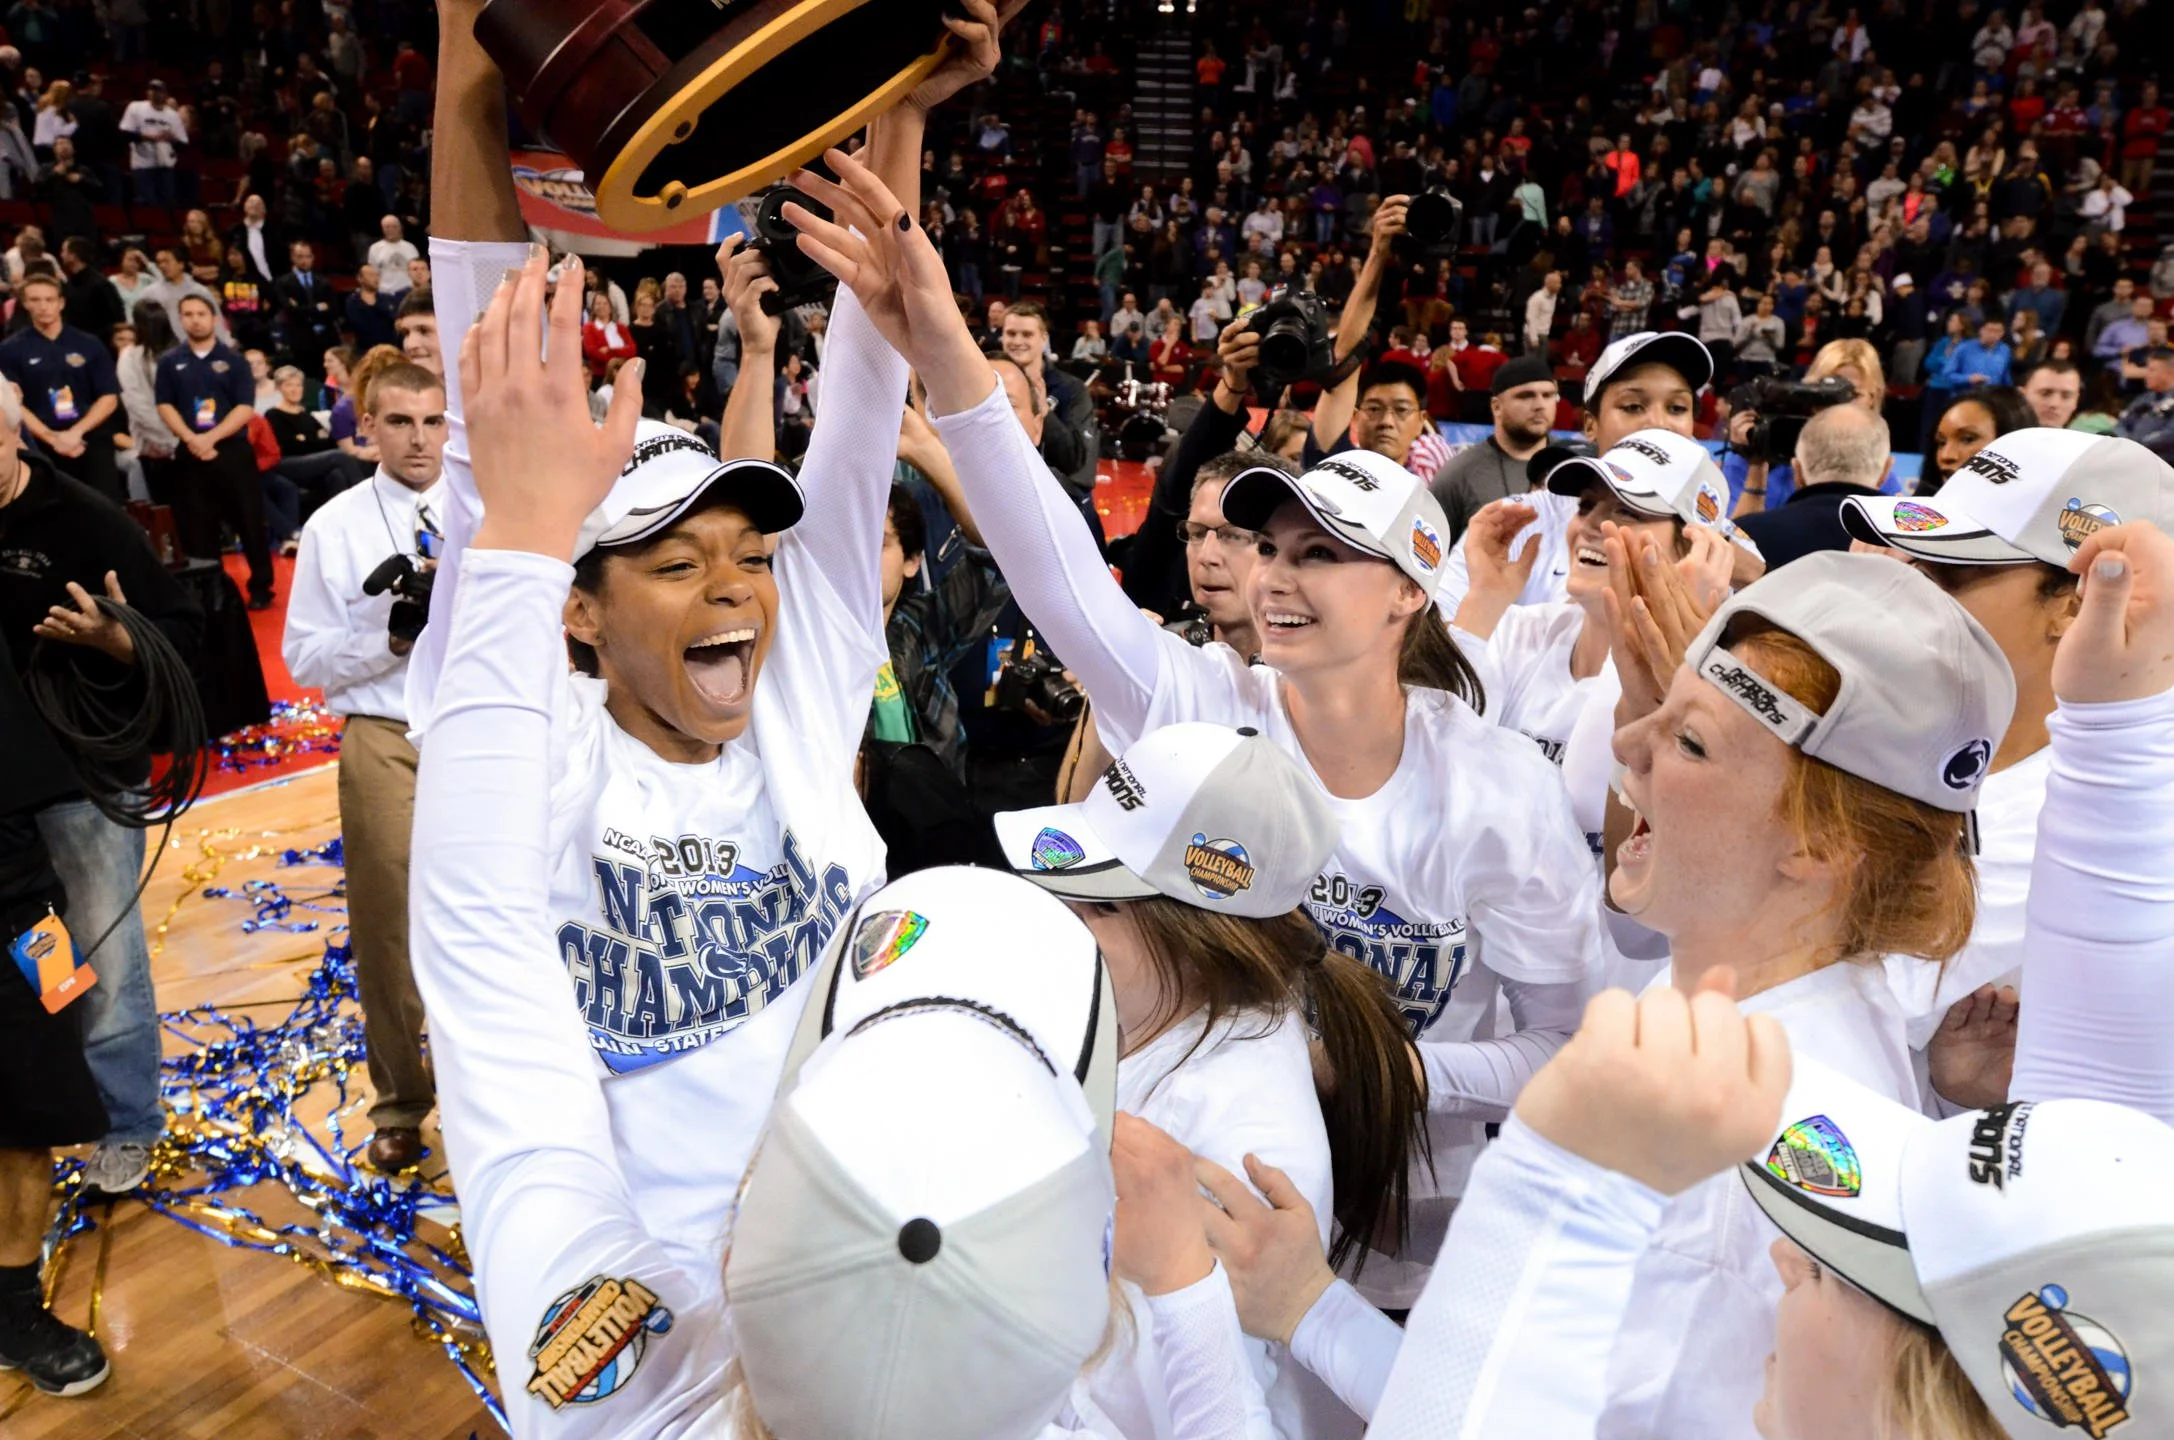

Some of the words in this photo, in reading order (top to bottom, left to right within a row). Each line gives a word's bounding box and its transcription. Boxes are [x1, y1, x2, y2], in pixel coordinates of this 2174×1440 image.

[1709, 664, 1789, 725] CHAMPIONS
[1119, 762, 1147, 799] NATIONAL
[650, 834, 740, 879] 2013
[1185, 846, 1255, 889] VOLLEYBALL
[1190, 867, 1240, 891] CHAMPIONSHIP
[680, 879, 751, 898] WOMEN'S
[2007, 1113, 2032, 1182] NATIONAL
[528, 1278, 659, 1408] VOLLEYBALL
[2005, 1294, 2129, 1439] VOLLEYBALL
[2003, 1330, 2084, 1423] CHAMPIONSHIP
